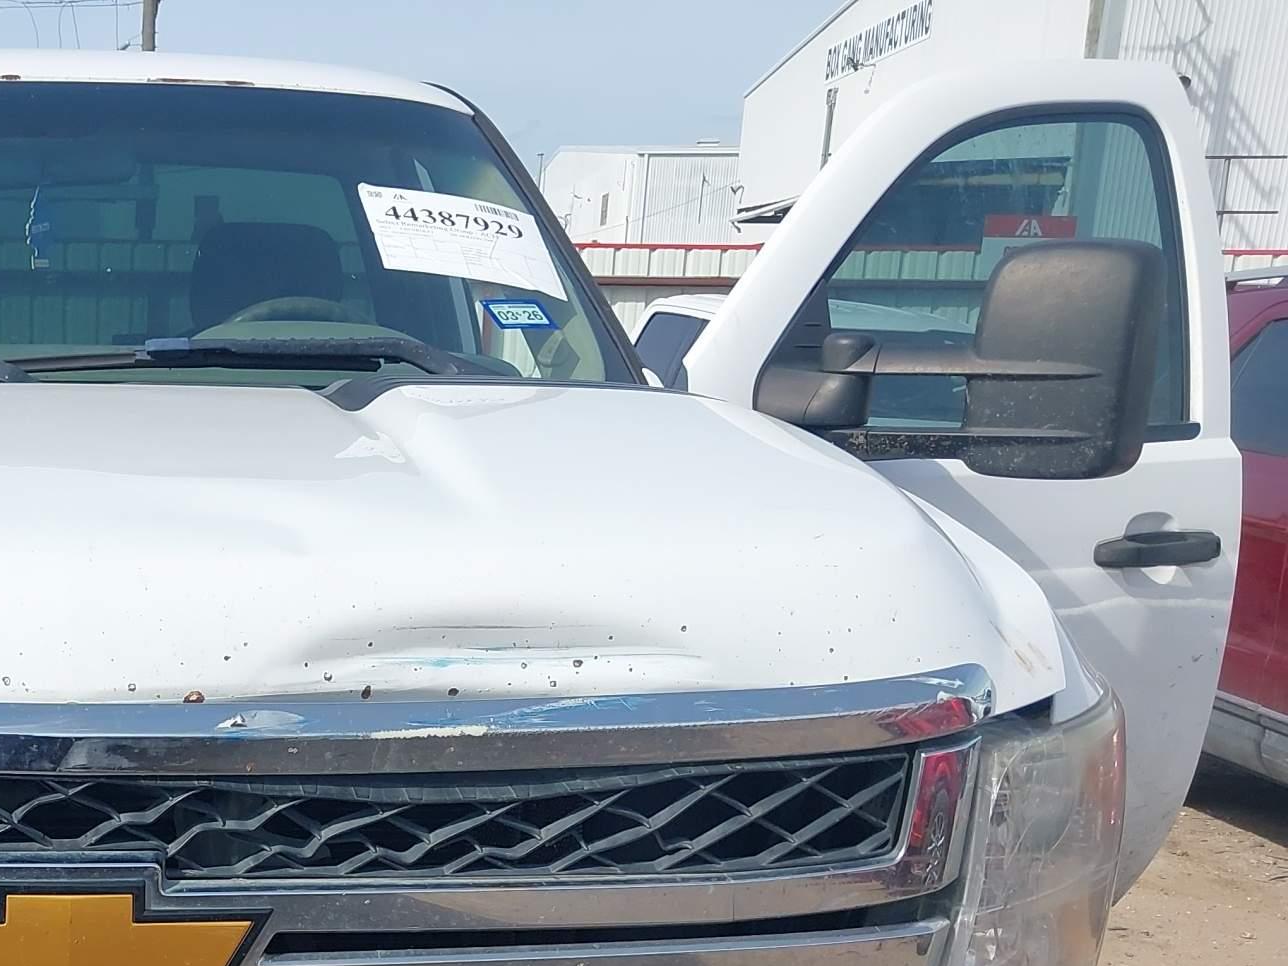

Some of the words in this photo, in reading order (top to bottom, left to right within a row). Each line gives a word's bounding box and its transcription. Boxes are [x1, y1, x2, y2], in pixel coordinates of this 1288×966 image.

[825, 43, 842, 80] BOX
[863, 0, 933, 63] MANUFACTURING
[384, 205, 524, 239] 44387929
